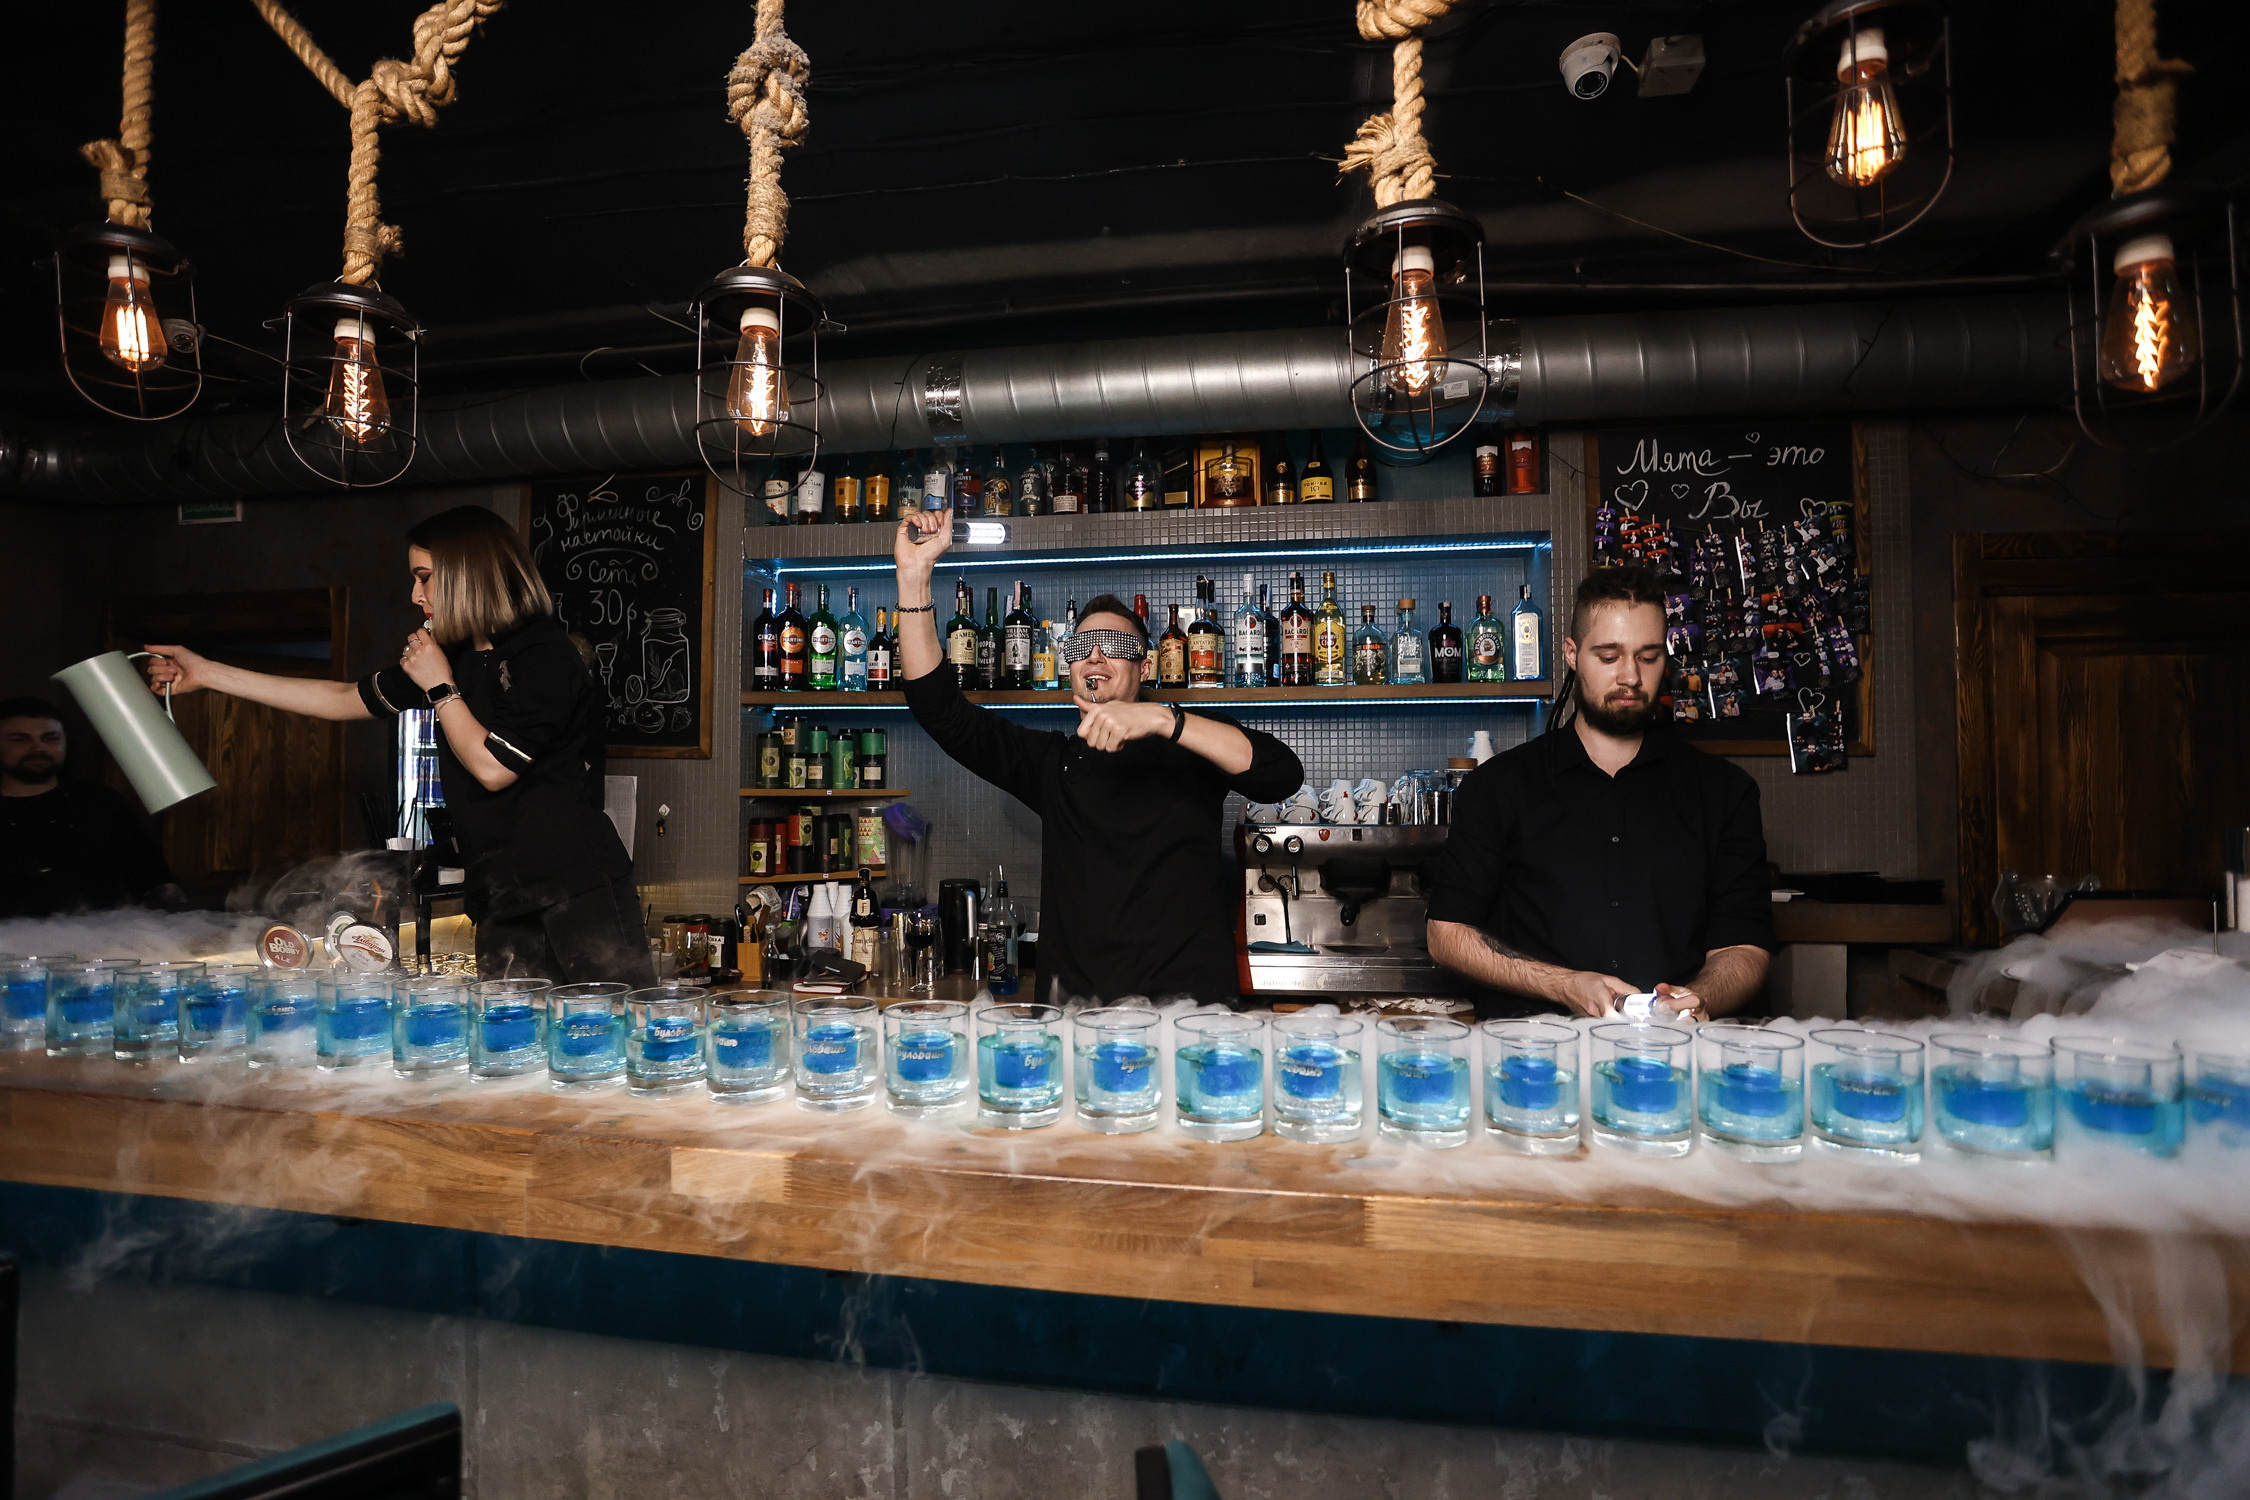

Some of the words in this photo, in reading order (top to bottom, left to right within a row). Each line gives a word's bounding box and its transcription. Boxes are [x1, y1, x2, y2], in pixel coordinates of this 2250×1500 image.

[1617, 438, 1732, 476] Мята
[1766, 444, 1825, 467] это
[1688, 481, 1769, 519] Вы
[561, 524, 665, 552] настойки
[1434, 647, 1462, 658] MOM
[268, 942, 301, 956] BOBBY
[273, 936, 295, 949] OLD
[274, 954, 291, 964] ALE
